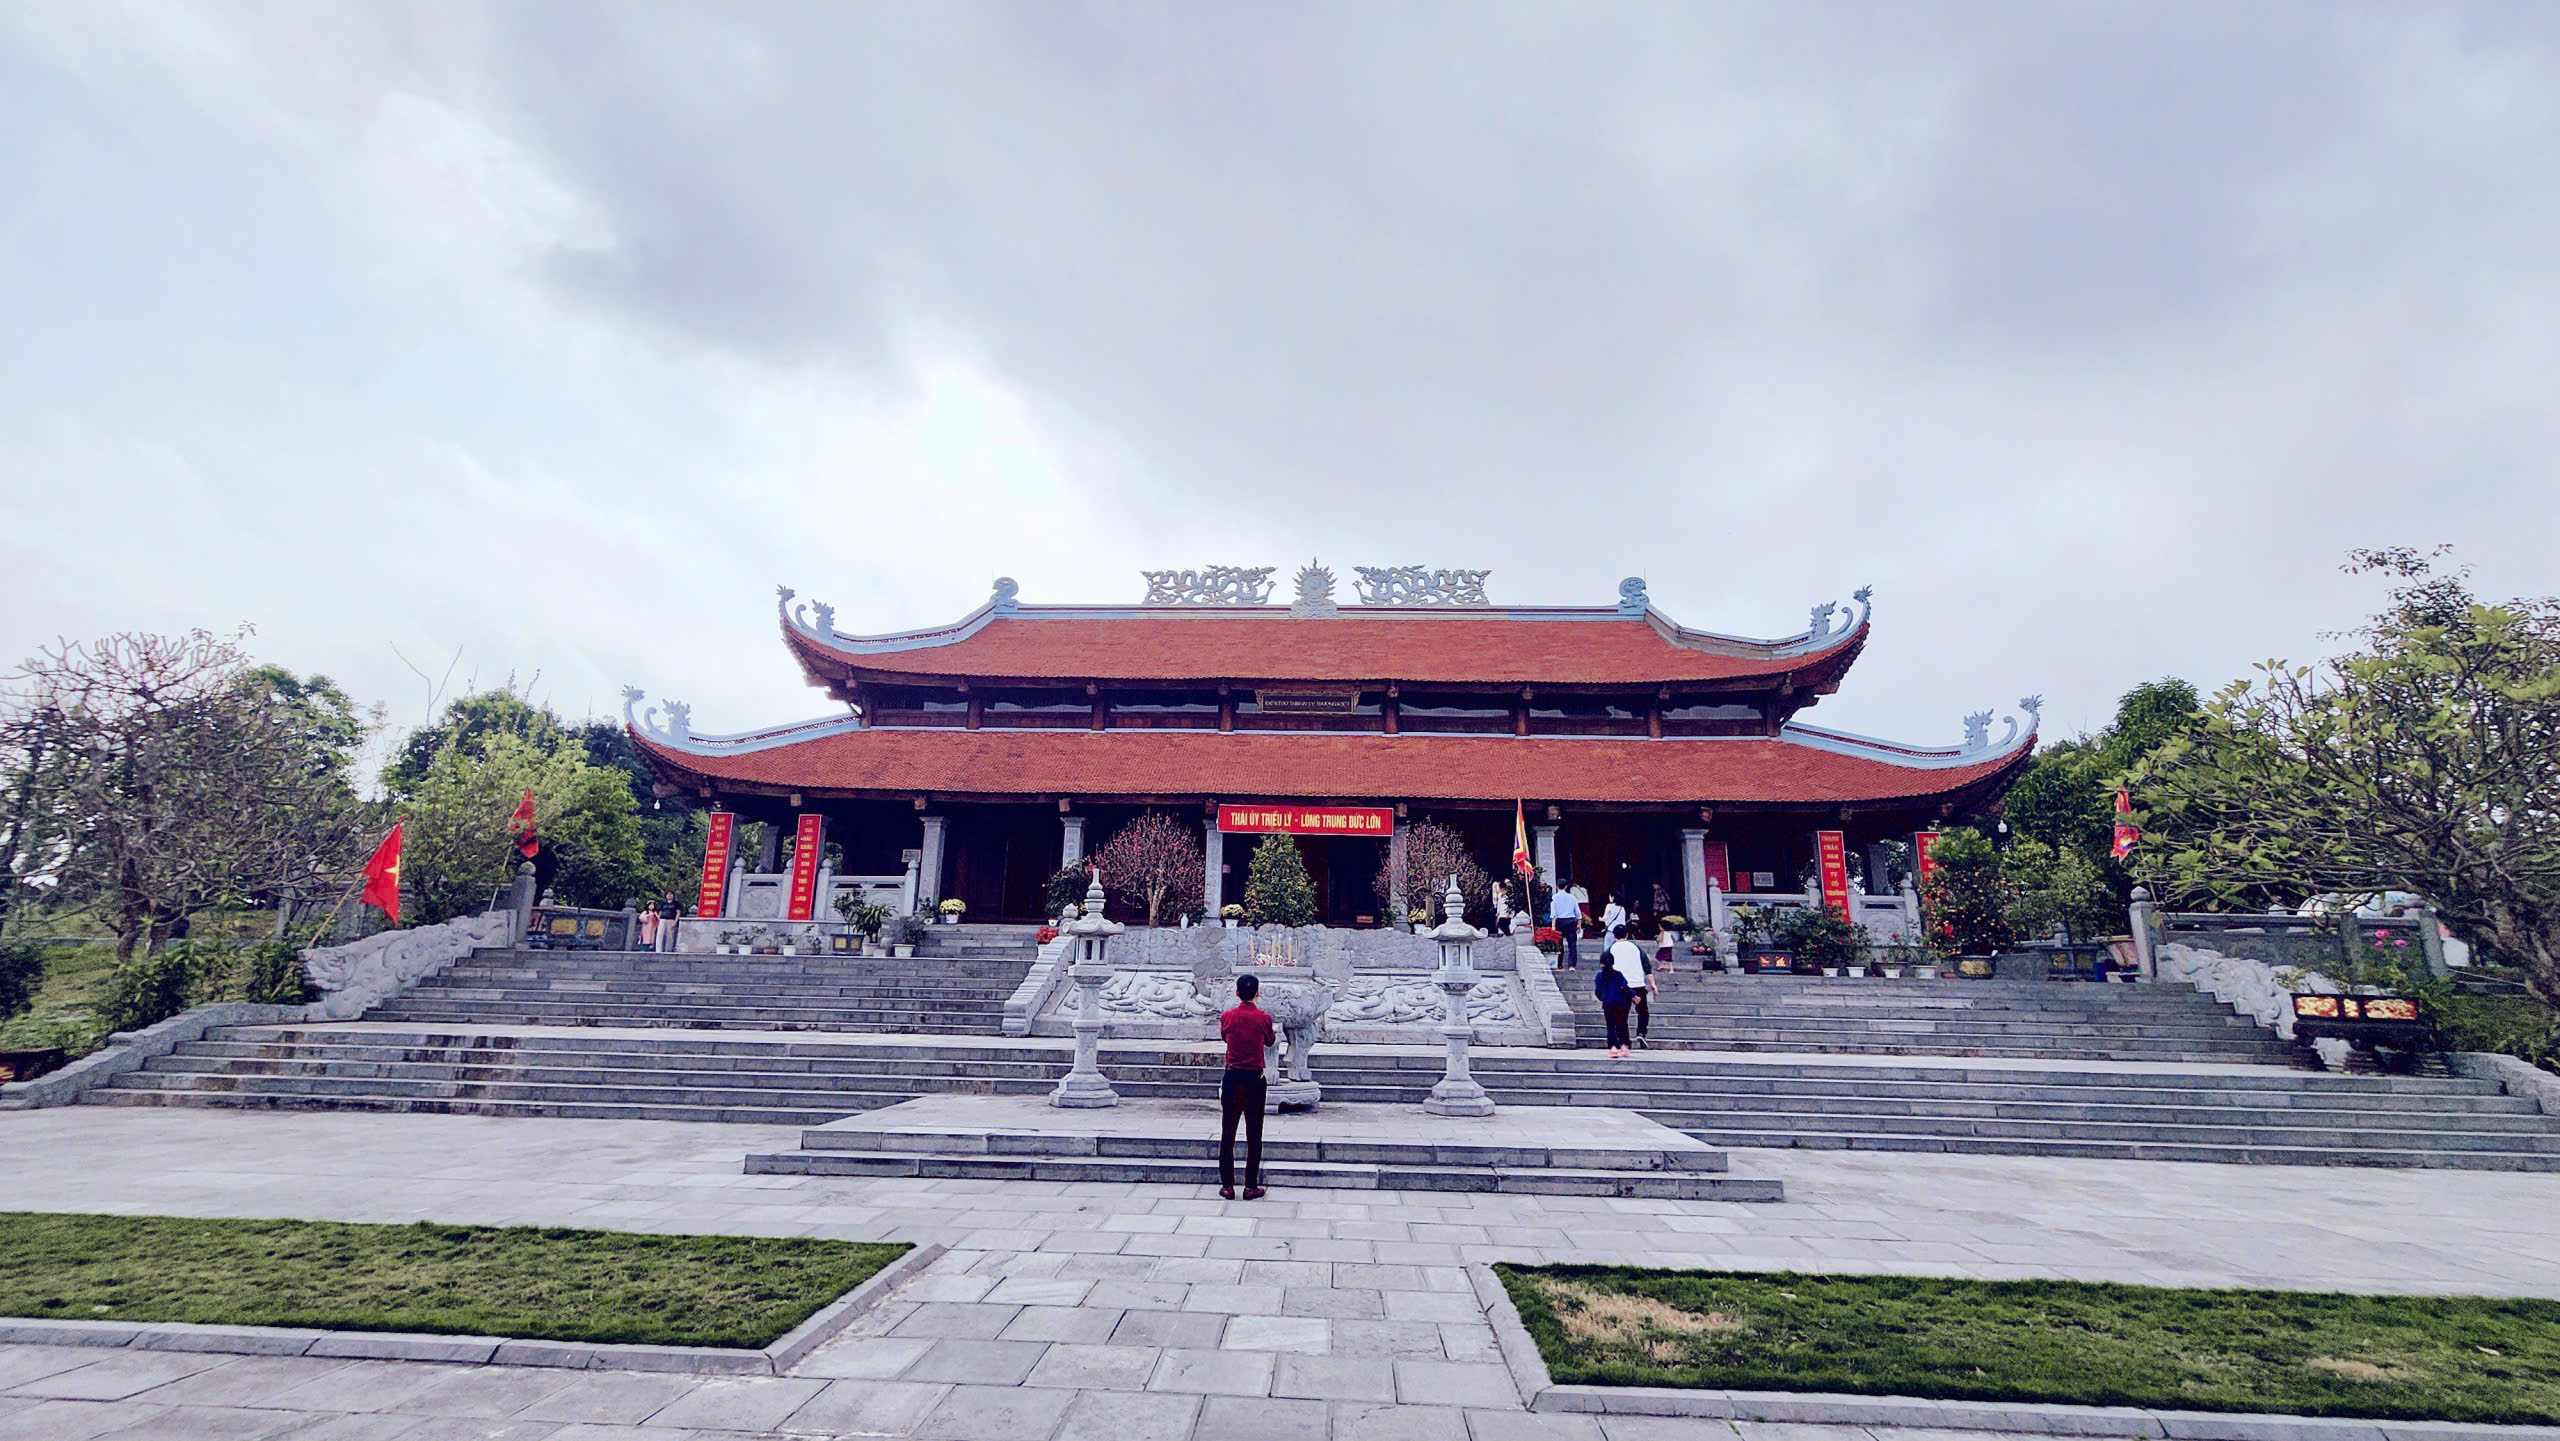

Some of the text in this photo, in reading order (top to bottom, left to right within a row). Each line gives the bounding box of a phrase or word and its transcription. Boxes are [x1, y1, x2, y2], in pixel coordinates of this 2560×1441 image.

[1231, 810, 1248, 826] THÁI
[1284, 811, 1293, 827] LÝ
[1322, 814, 1347, 829] TRUNG
[1348, 812, 1364, 829] ĐỨC
[1366, 812, 1381, 829] LỚN
